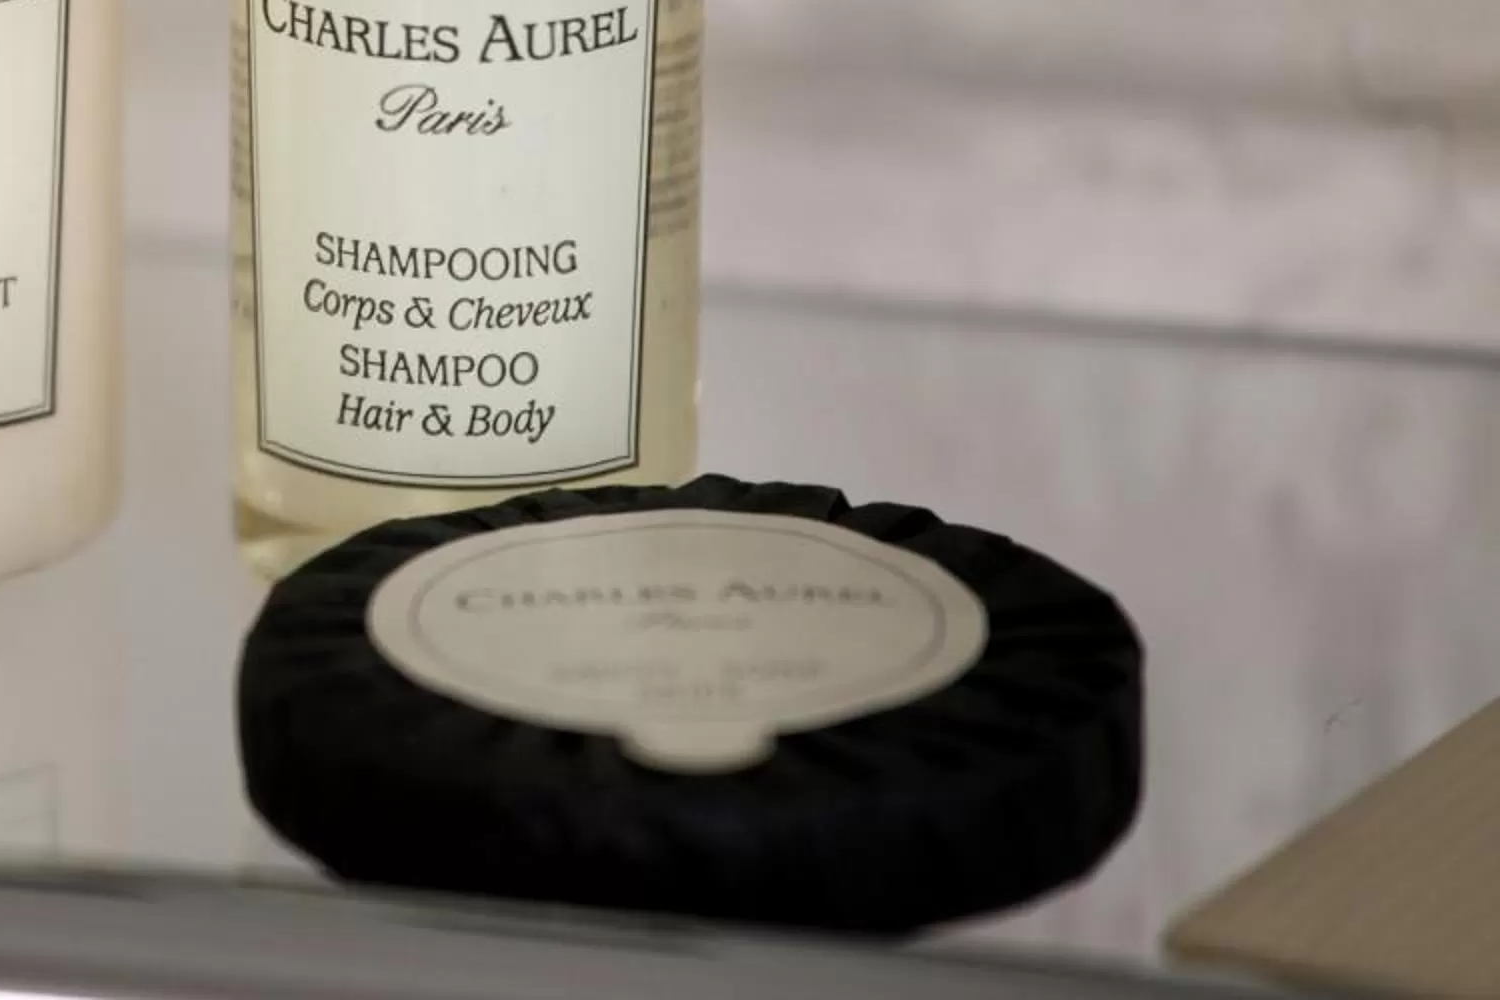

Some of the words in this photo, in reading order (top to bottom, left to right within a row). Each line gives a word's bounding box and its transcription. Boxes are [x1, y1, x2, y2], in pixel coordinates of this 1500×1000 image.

[478, 6, 638, 64] AUREL
[375, 84, 512, 136] Paris
[315, 231, 579, 281] SHAMPOOING
[303, 278, 395, 331] Corps
[405, 297, 437, 329] &
[449, 290, 593, 331] Cheveux
[340, 343, 540, 387] SHAMPOO
[337, 393, 414, 433] Hair
[422, 405, 455, 435] &
[465, 399, 556, 444] Body
